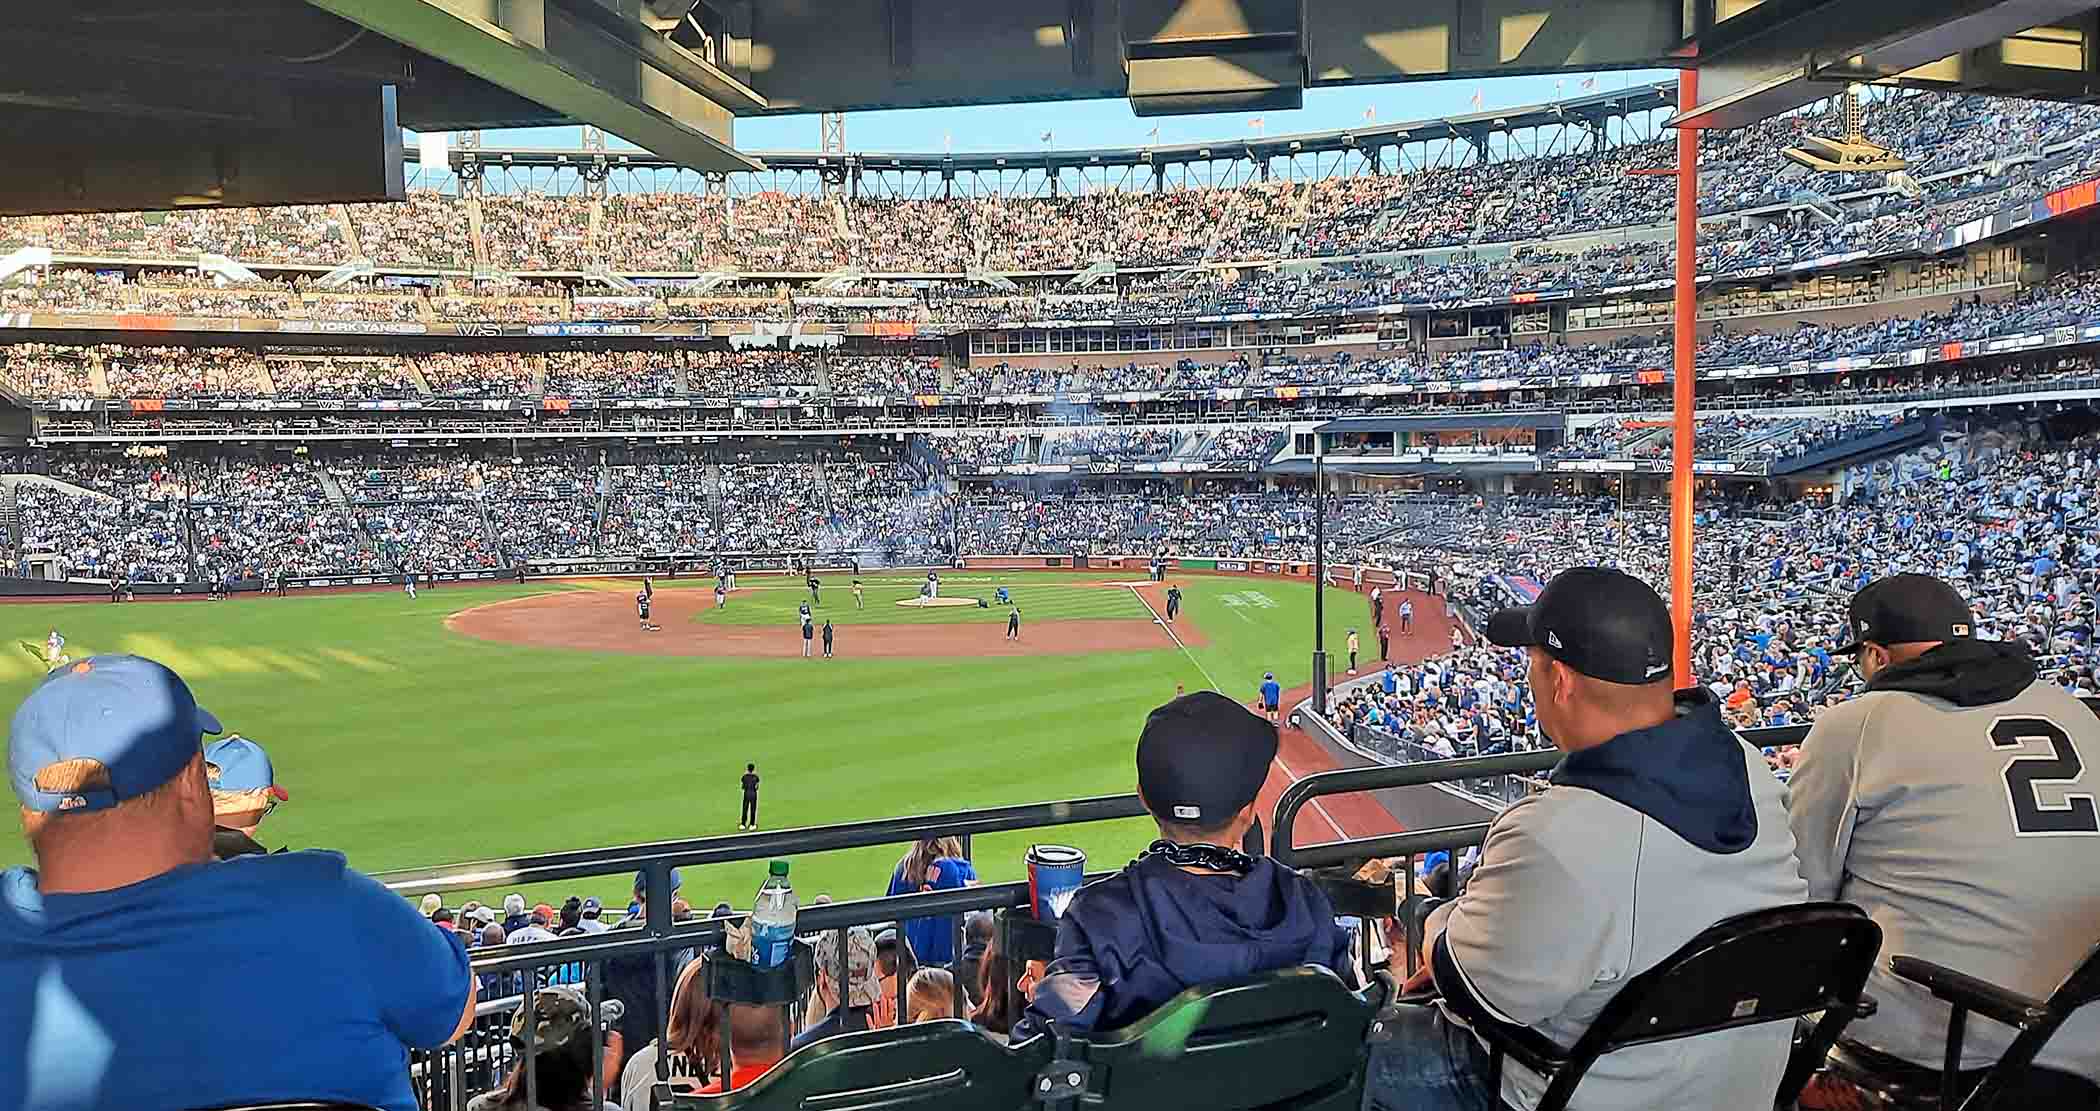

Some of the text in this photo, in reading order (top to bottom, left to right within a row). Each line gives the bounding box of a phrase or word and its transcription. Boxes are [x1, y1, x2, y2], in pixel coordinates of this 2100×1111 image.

[279, 321, 427, 334] NEW YORK YANKEES
[527, 325, 641, 335] NEW YORK METS
[1985, 714, 2100, 837] 2
